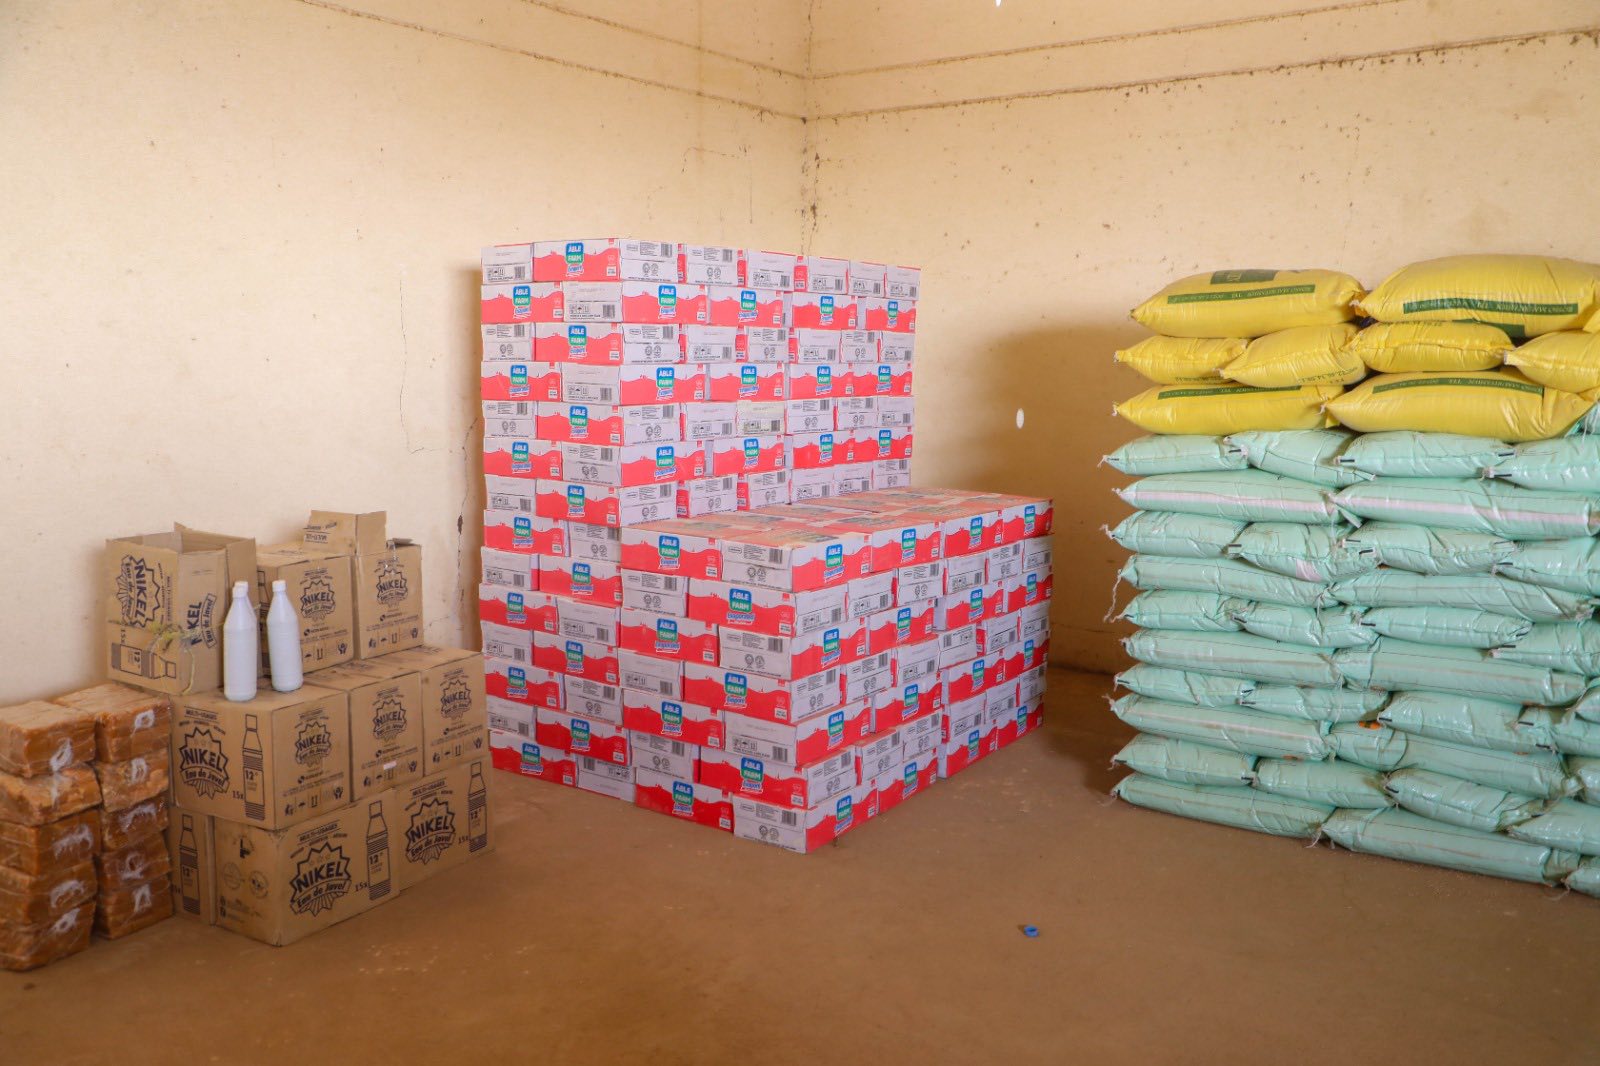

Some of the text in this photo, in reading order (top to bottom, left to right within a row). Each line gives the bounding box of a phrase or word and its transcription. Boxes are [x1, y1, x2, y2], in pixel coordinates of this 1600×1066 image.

[134, 564, 147, 618] NIKEL
[379, 580, 403, 592] NIKEL
[303, 592, 330, 606] NIKEL
[444, 691, 468, 705] NIKEL
[375, 710, 402, 725] NIKEL
[298, 734, 327, 749] NIKEL
[184, 748, 222, 772] NIKEL
[410, 816, 449, 842] NIKEL
[296, 861, 343, 892] NIKEL
